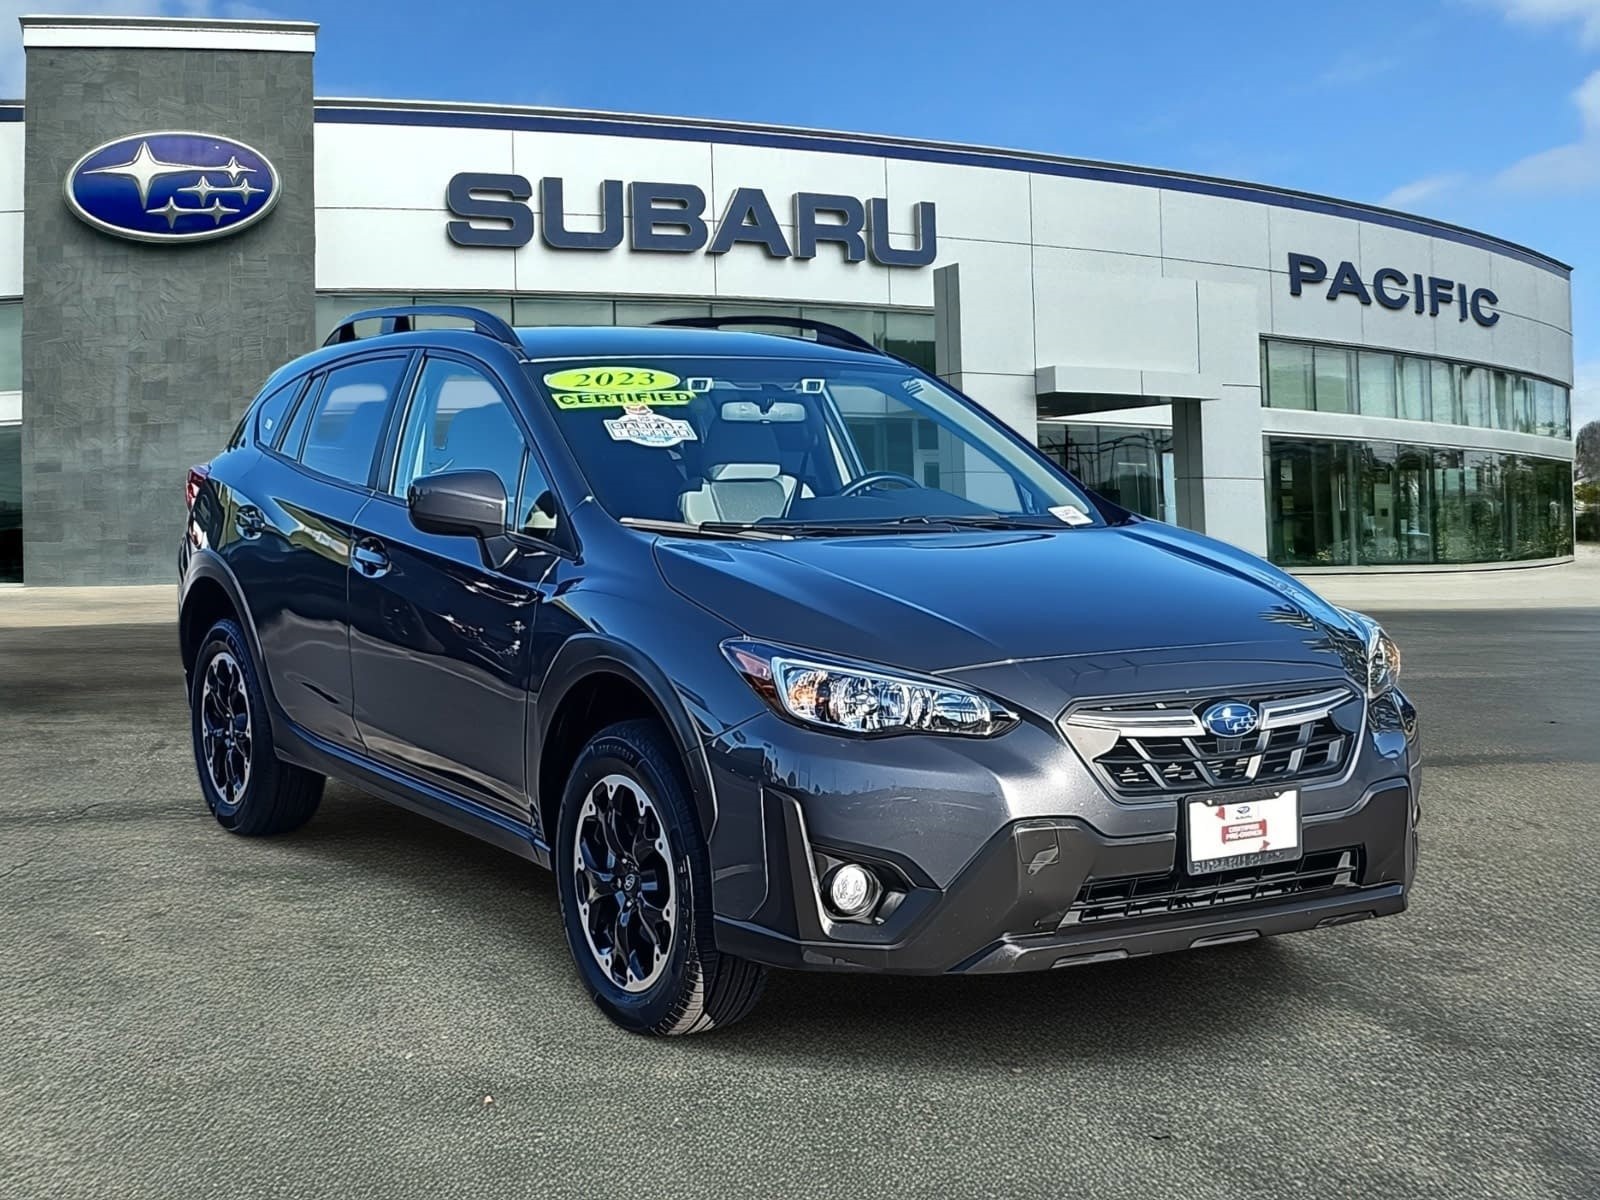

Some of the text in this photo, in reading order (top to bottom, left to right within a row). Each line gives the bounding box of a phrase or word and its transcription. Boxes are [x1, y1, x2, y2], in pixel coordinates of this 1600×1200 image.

[446, 172, 937, 267] SUBARU
[1288, 252, 1500, 327] PACIFIC
[559, 392, 690, 405] CERTIFIED
[574, 372, 655, 387] 2023
